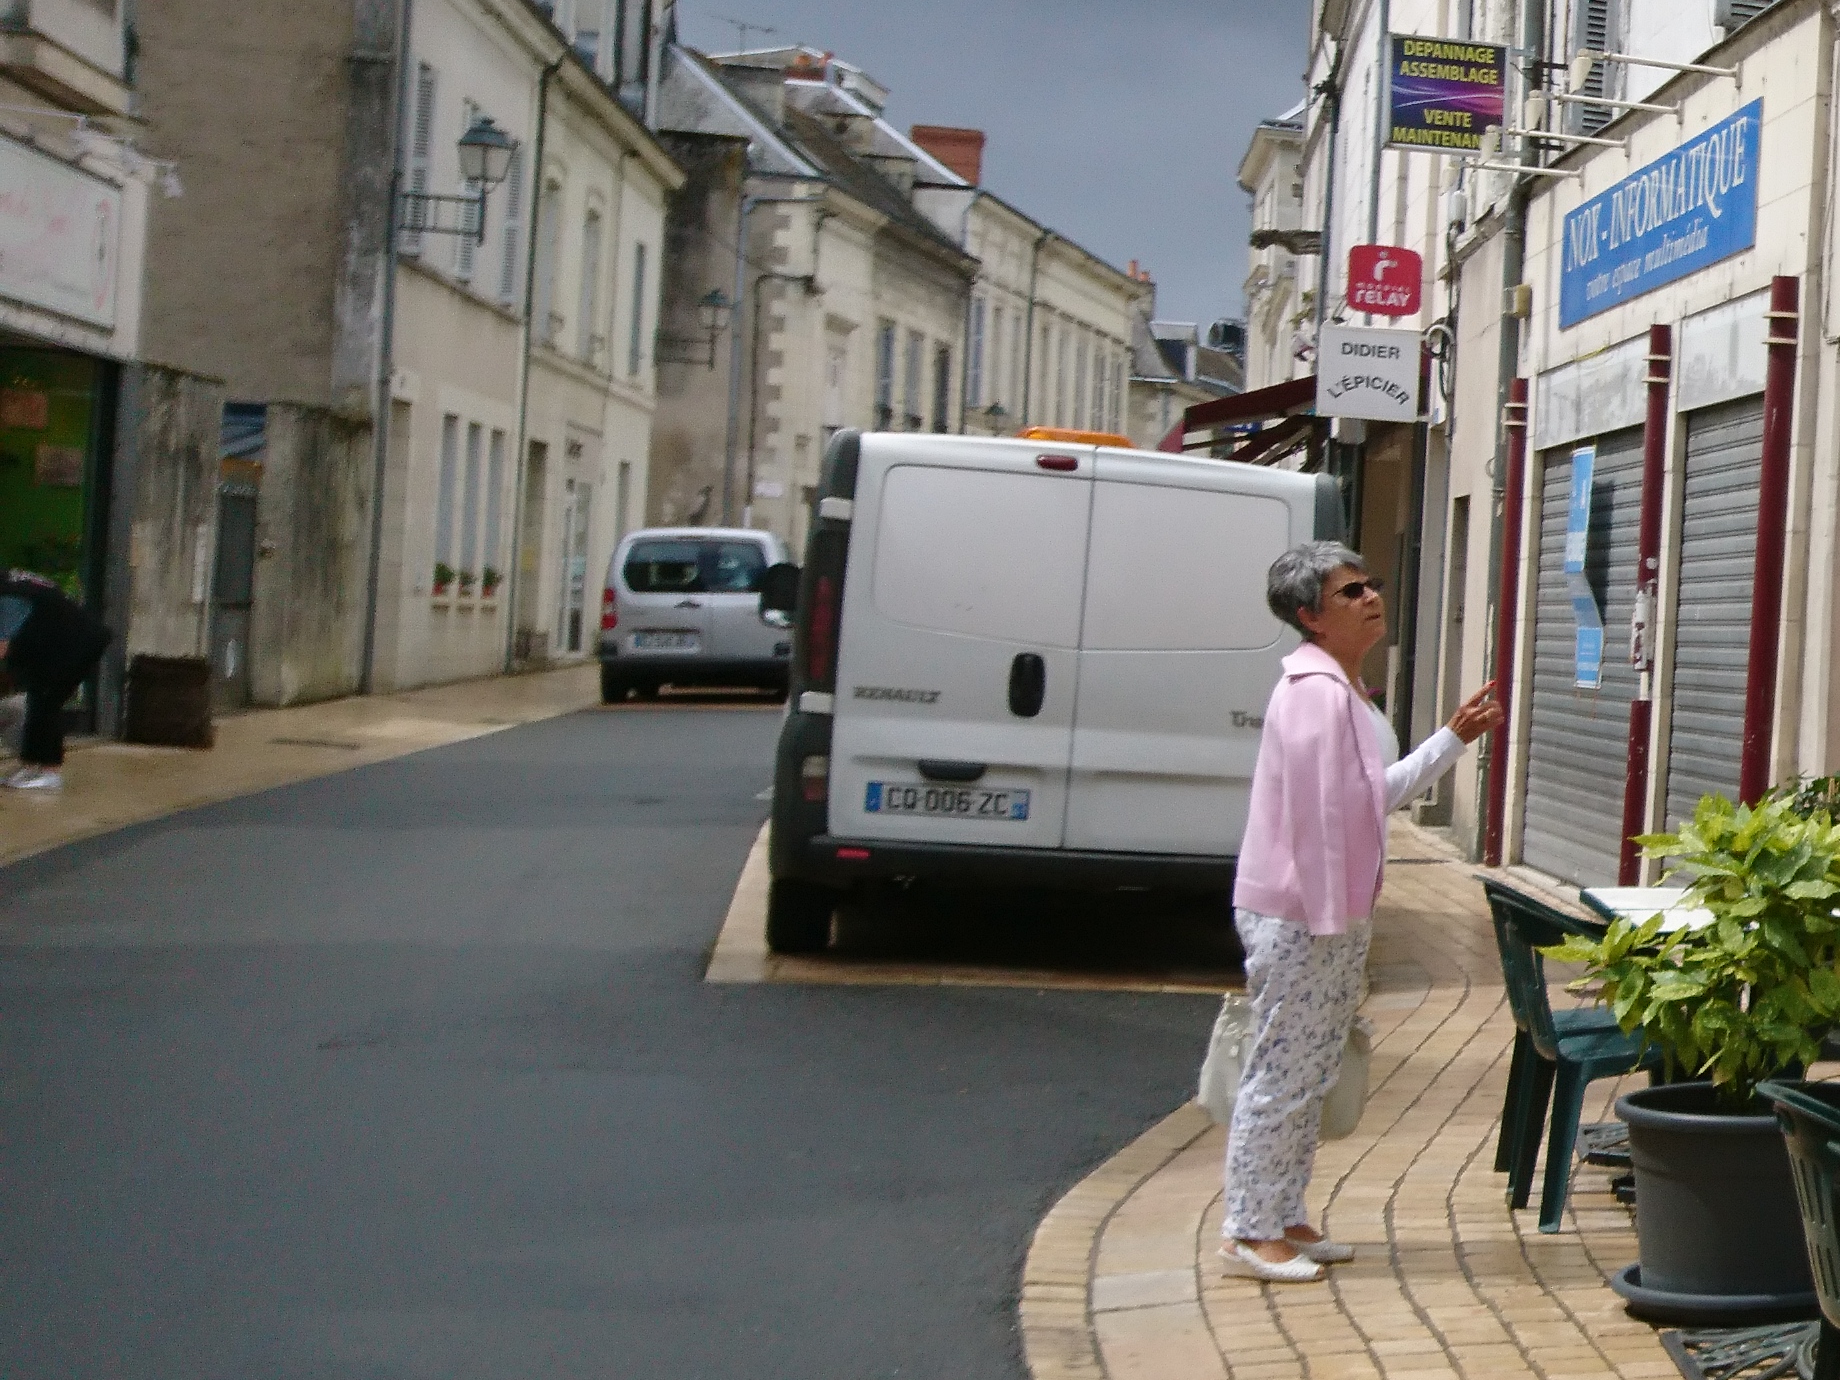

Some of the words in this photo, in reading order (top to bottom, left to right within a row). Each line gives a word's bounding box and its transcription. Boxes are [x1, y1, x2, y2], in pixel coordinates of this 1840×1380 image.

[1403, 40, 1495, 64] DEPANNAGE
[1400, 60, 1498, 85] ASSEMBLAGE
[1423, 108, 1473, 128] VENTE
[1609, 116, 1748, 251] INFORMATIQUE
[1341, 342, 1400, 360] DIDIER
[1327, 374, 1410, 406] L'ÉPICIER
